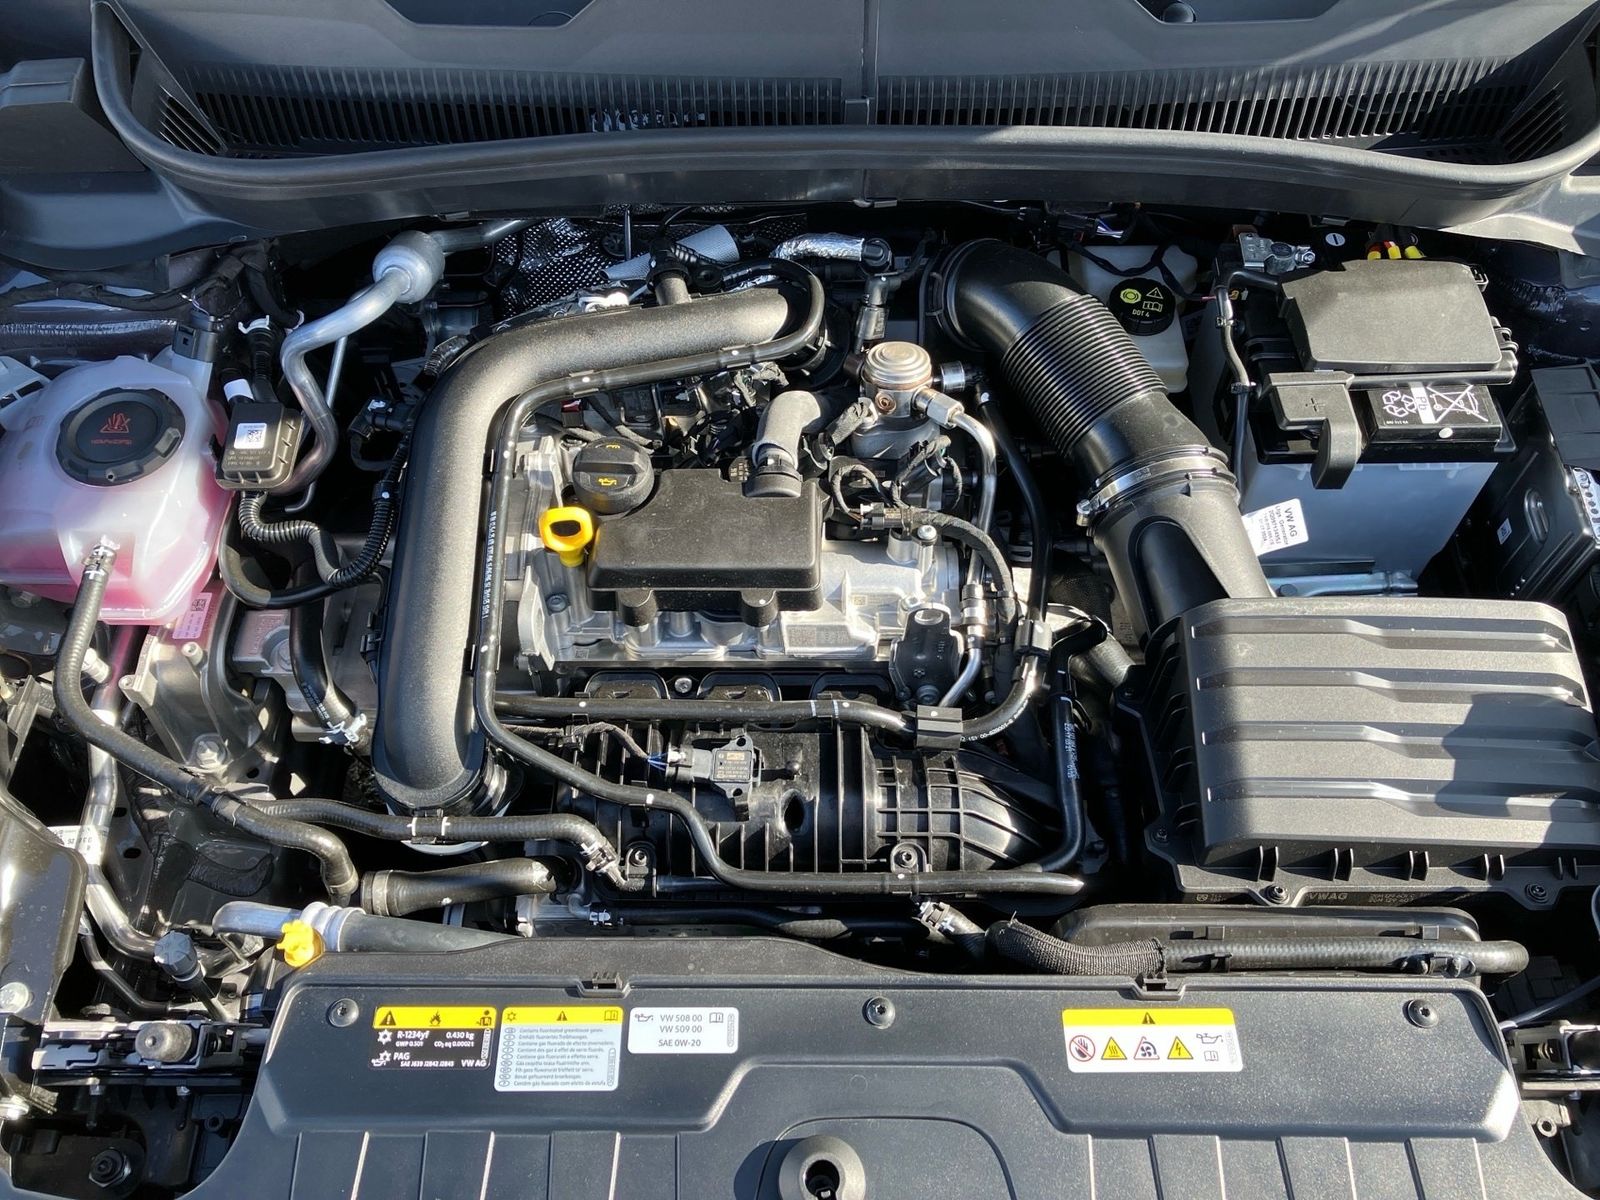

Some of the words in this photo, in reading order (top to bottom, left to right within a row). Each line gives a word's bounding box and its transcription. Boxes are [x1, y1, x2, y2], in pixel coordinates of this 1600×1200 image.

[1132, 308, 1144, 316] DOT
[1416, 396, 1427, 411] Pb
[1284, 507, 1294, 523] VW
[1287, 523, 1298, 538] AG
[660, 1014, 674, 1022] VW
[675, 1014, 691, 1022] 508
[692, 1014, 703, 1022] 00
[659, 1025, 674, 1033] VW
[675, 1025, 690, 1033] 509
[691, 1025, 703, 1033] 00
[397, 1030, 430, 1040] R-1234yf
[446, 1031, 465, 1039] 0.430
[465, 1031, 475, 1040] kg
[658, 1039, 673, 1047] SAE
[674, 1039, 702, 1047] 0W-20
[393, 1052, 410, 1060] PAG
